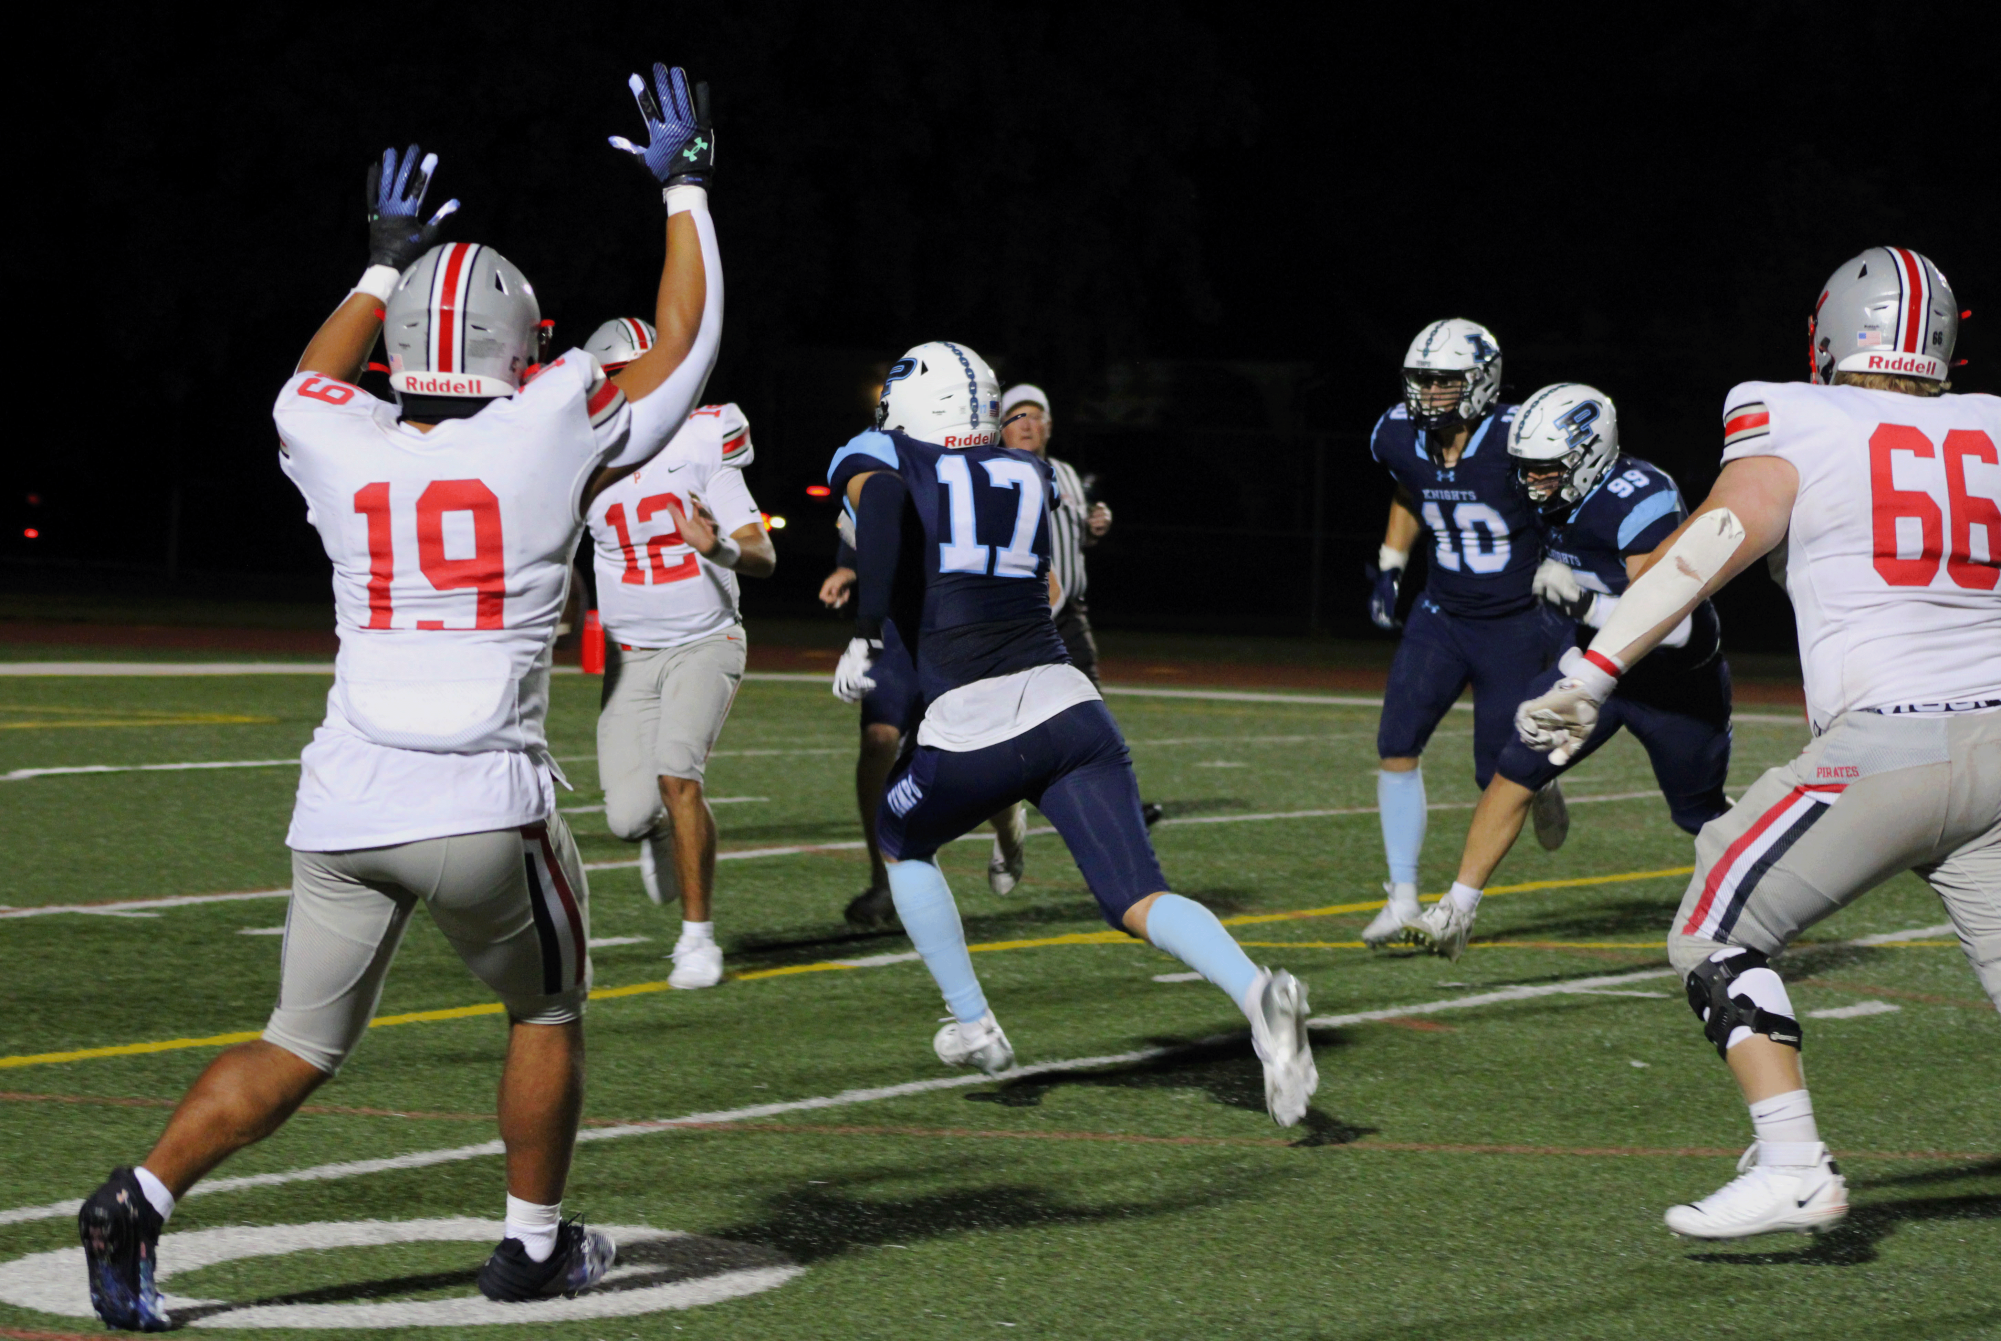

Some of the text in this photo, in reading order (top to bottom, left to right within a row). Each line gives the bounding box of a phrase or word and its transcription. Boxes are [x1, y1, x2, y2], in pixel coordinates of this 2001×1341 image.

[1932, 331, 1943, 345] 66
[1868, 355, 1936, 375] Riddell
[405, 376, 482, 395] Riddell
[1553, 400, 1600, 449] P
[945, 432, 996, 448] Riddell
[1422, 489, 1477, 500] KNIGHTS
[1607, 469, 1650, 498] 99
[935, 454, 1044, 578] 17
[1868, 422, 2001, 590] 66
[605, 492, 701, 586] 12
[1421, 501, 1511, 574] 10
[354, 478, 506, 630] 19
[1816, 766, 1860, 778] PIRATES
